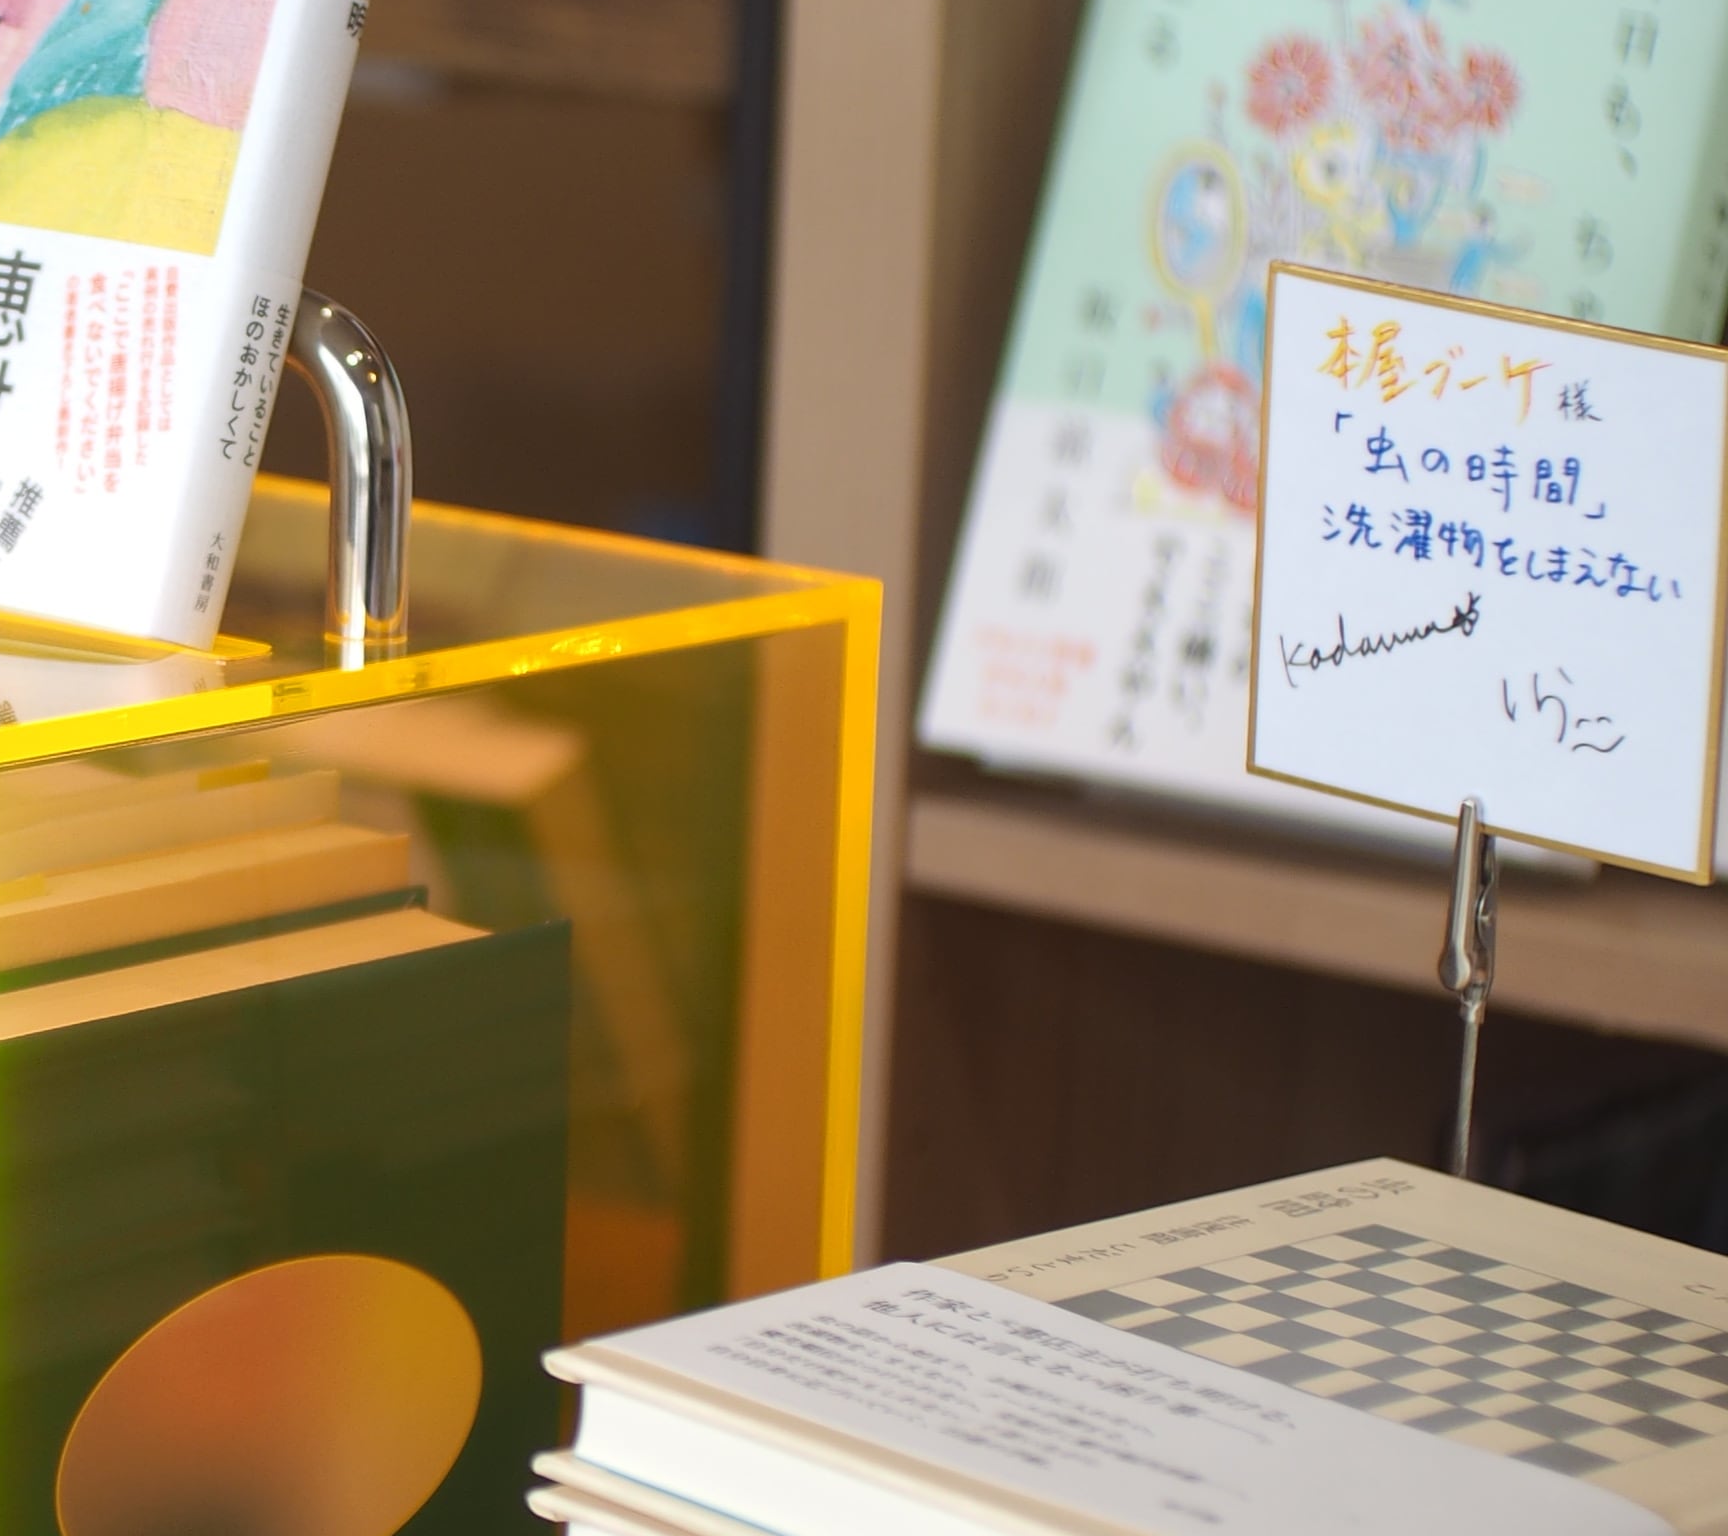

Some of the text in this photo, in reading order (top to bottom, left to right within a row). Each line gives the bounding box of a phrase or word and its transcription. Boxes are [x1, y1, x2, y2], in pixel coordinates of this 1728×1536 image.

[218, 294, 271, 461] ほのおかしくて
[243, 302, 291, 467] 生きていること
[1334, 409, 1607, 521] 「虫の時間」
[194, 531, 226, 614] 大和書房
[1320, 500, 1685, 603] 洗濯物をしまえない
